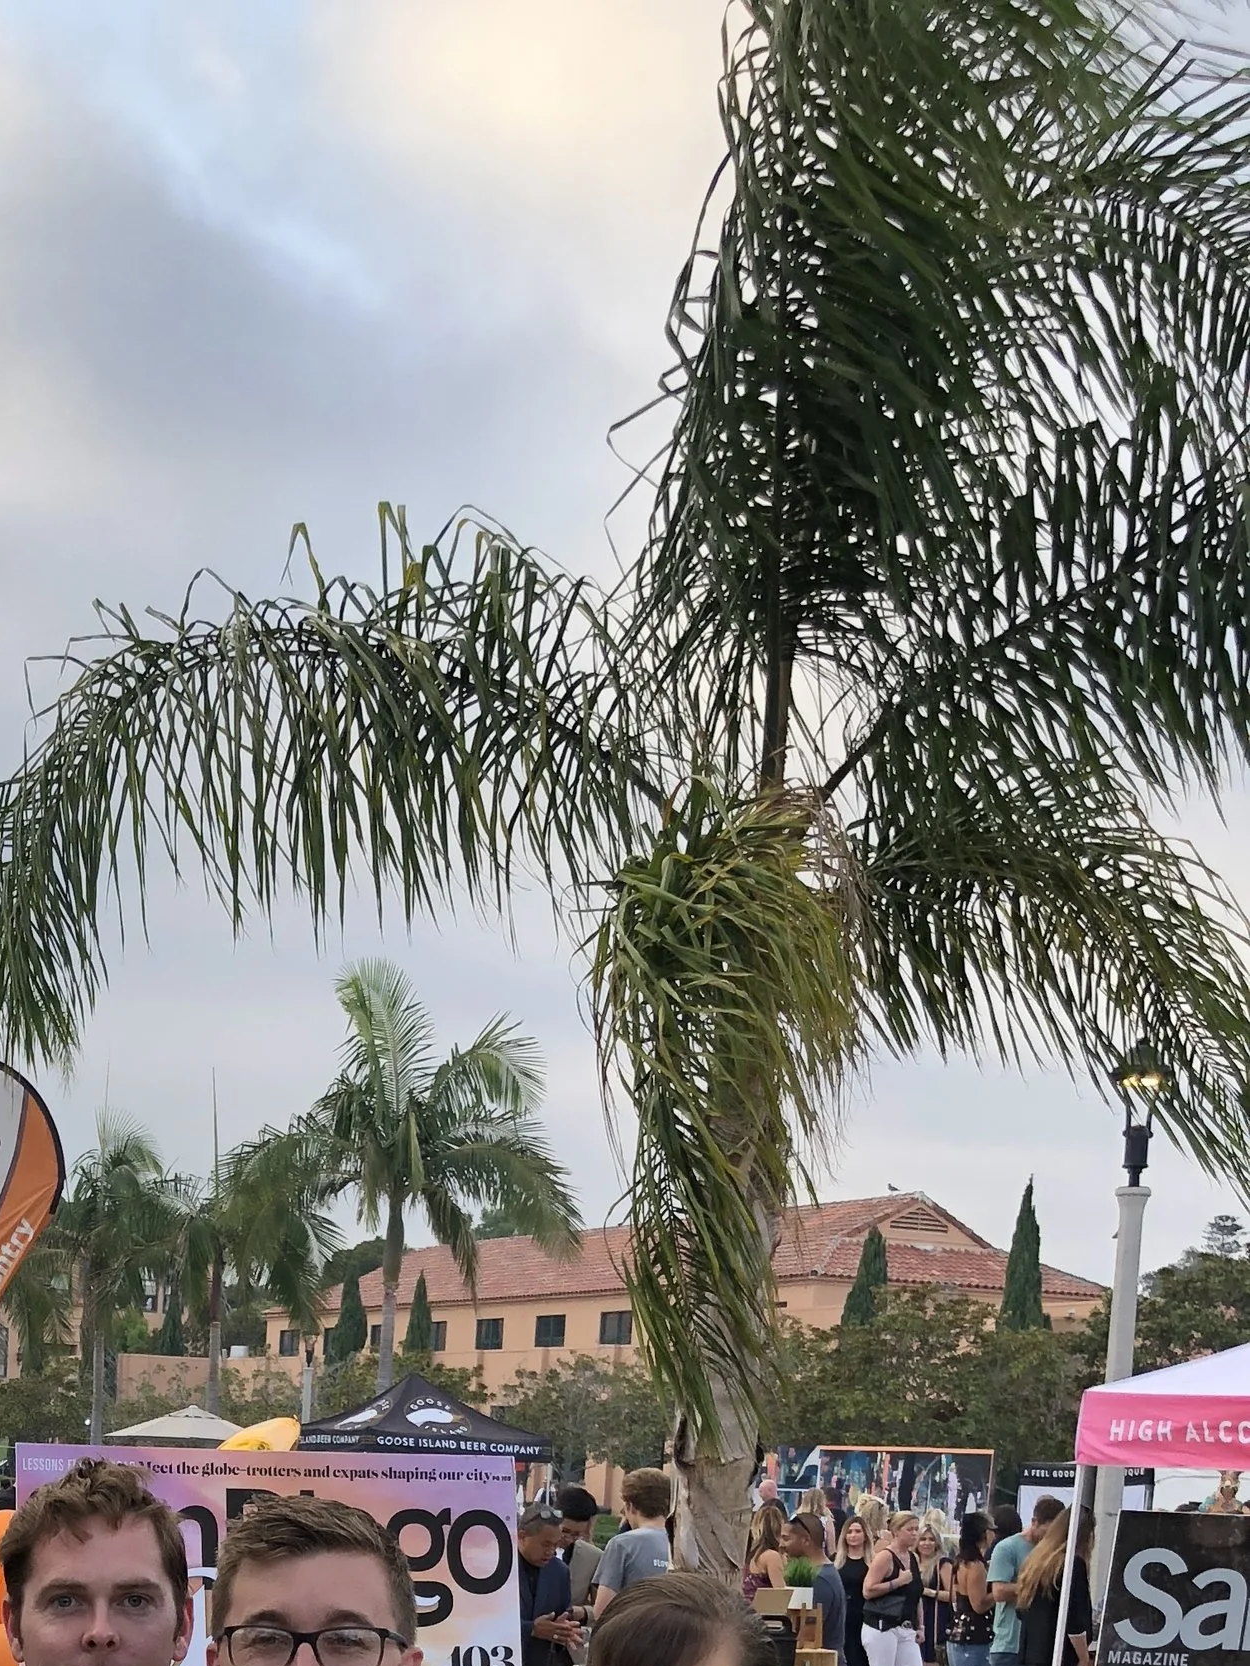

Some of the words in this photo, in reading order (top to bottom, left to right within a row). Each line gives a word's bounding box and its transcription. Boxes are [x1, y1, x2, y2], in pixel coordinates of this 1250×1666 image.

[1110, 1419, 1173, 1442] HIGH
[376, 1436, 415, 1447] GOOSE
[418, 1438, 457, 1449] ISLAND
[460, 1441, 487, 1452] BEER
[489, 1443, 541, 1456] COMPANY
[22, 1457, 64, 1472] LESSONS
[176, 1461, 200, 1475] the
[201, 1461, 301, 1478] globe-trotters
[303, 1465, 330, 1479] and
[332, 1466, 379, 1483] expats
[381, 1466, 437, 1483] shaping
[438, 1471, 464, 1482] our
[466, 1469, 492, 1484] city
[1031, 1468, 1050, 1478] FEEL
[1113, 1547, 1250, 1652] Sa
